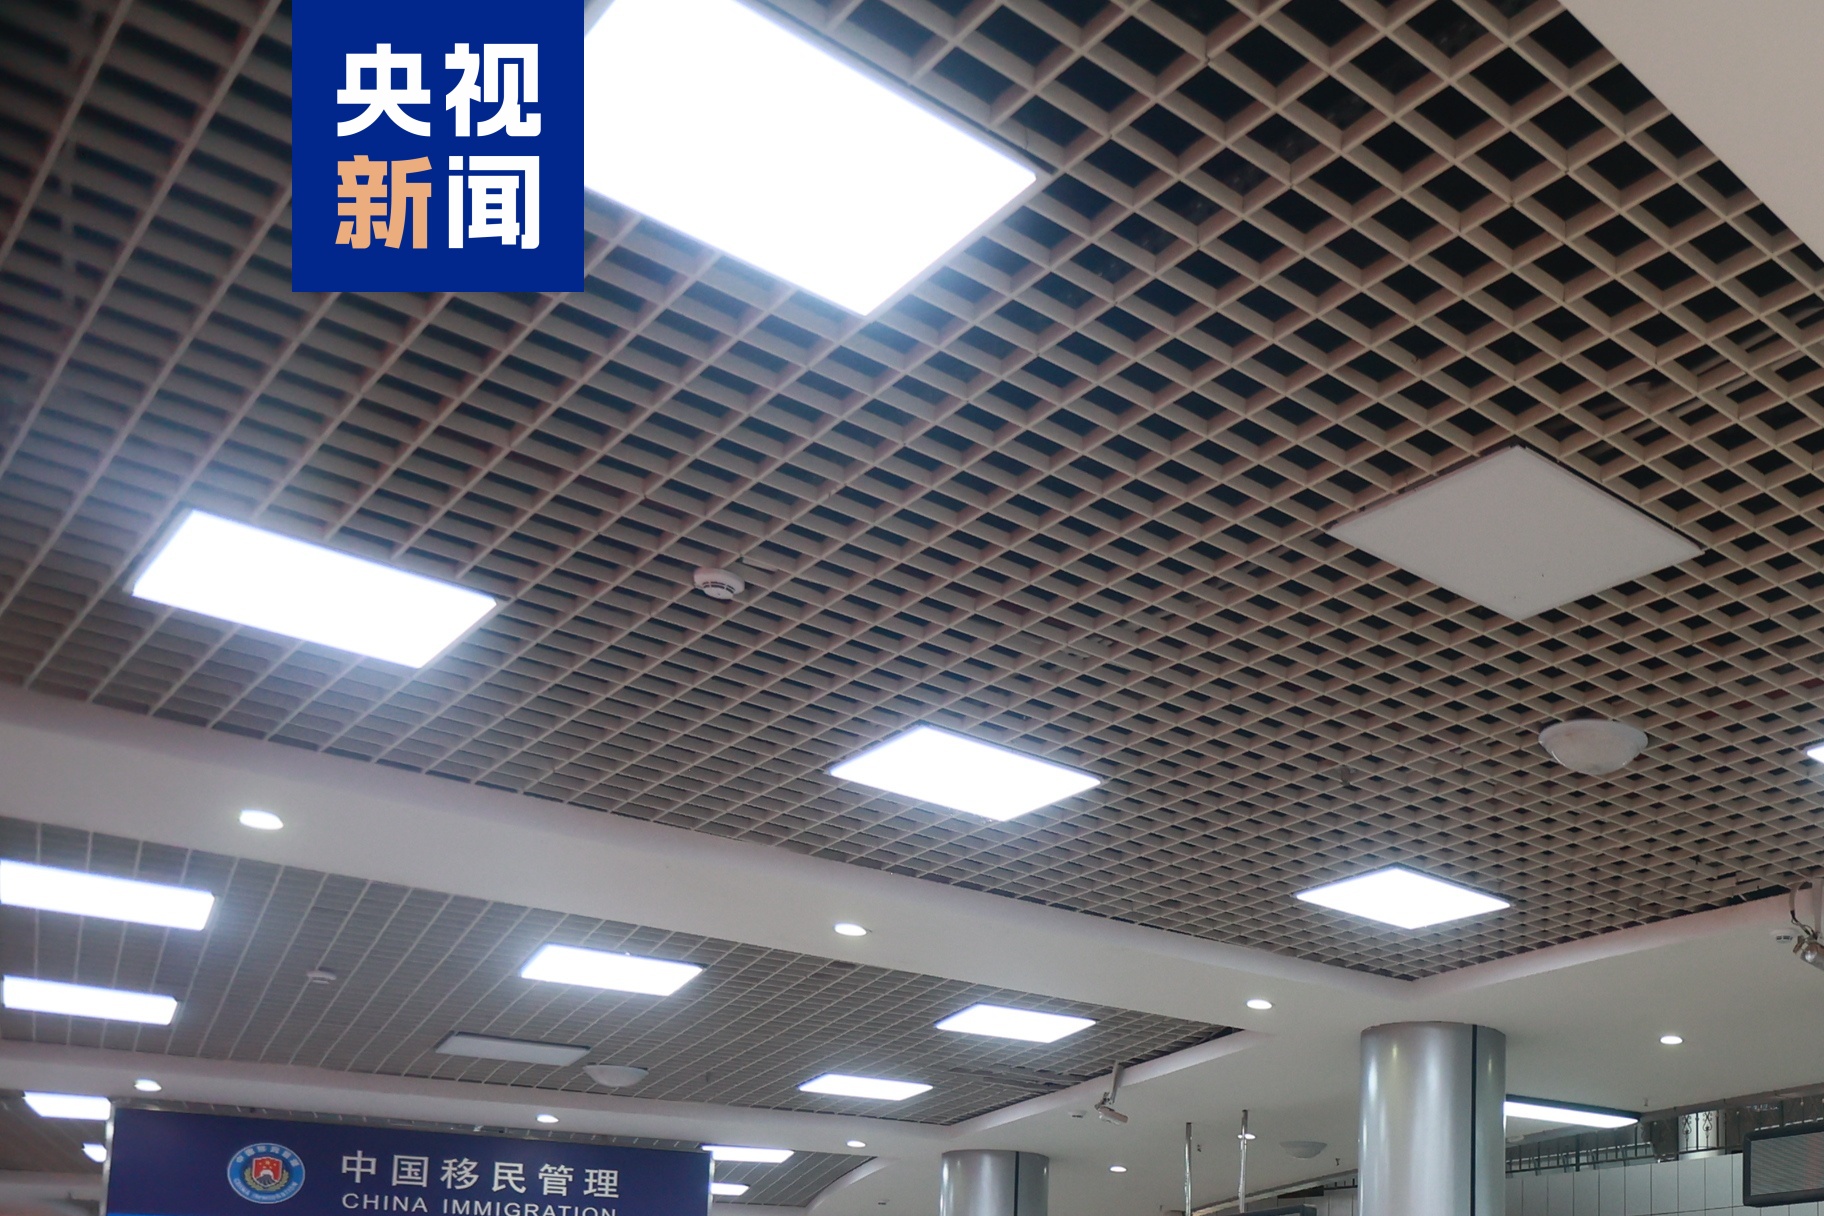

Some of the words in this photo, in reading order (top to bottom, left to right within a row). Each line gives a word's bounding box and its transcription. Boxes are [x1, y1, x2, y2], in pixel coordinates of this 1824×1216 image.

[342, 1150, 620, 1199] 中国移民管理
[342, 1193, 428, 1213] CHINA
